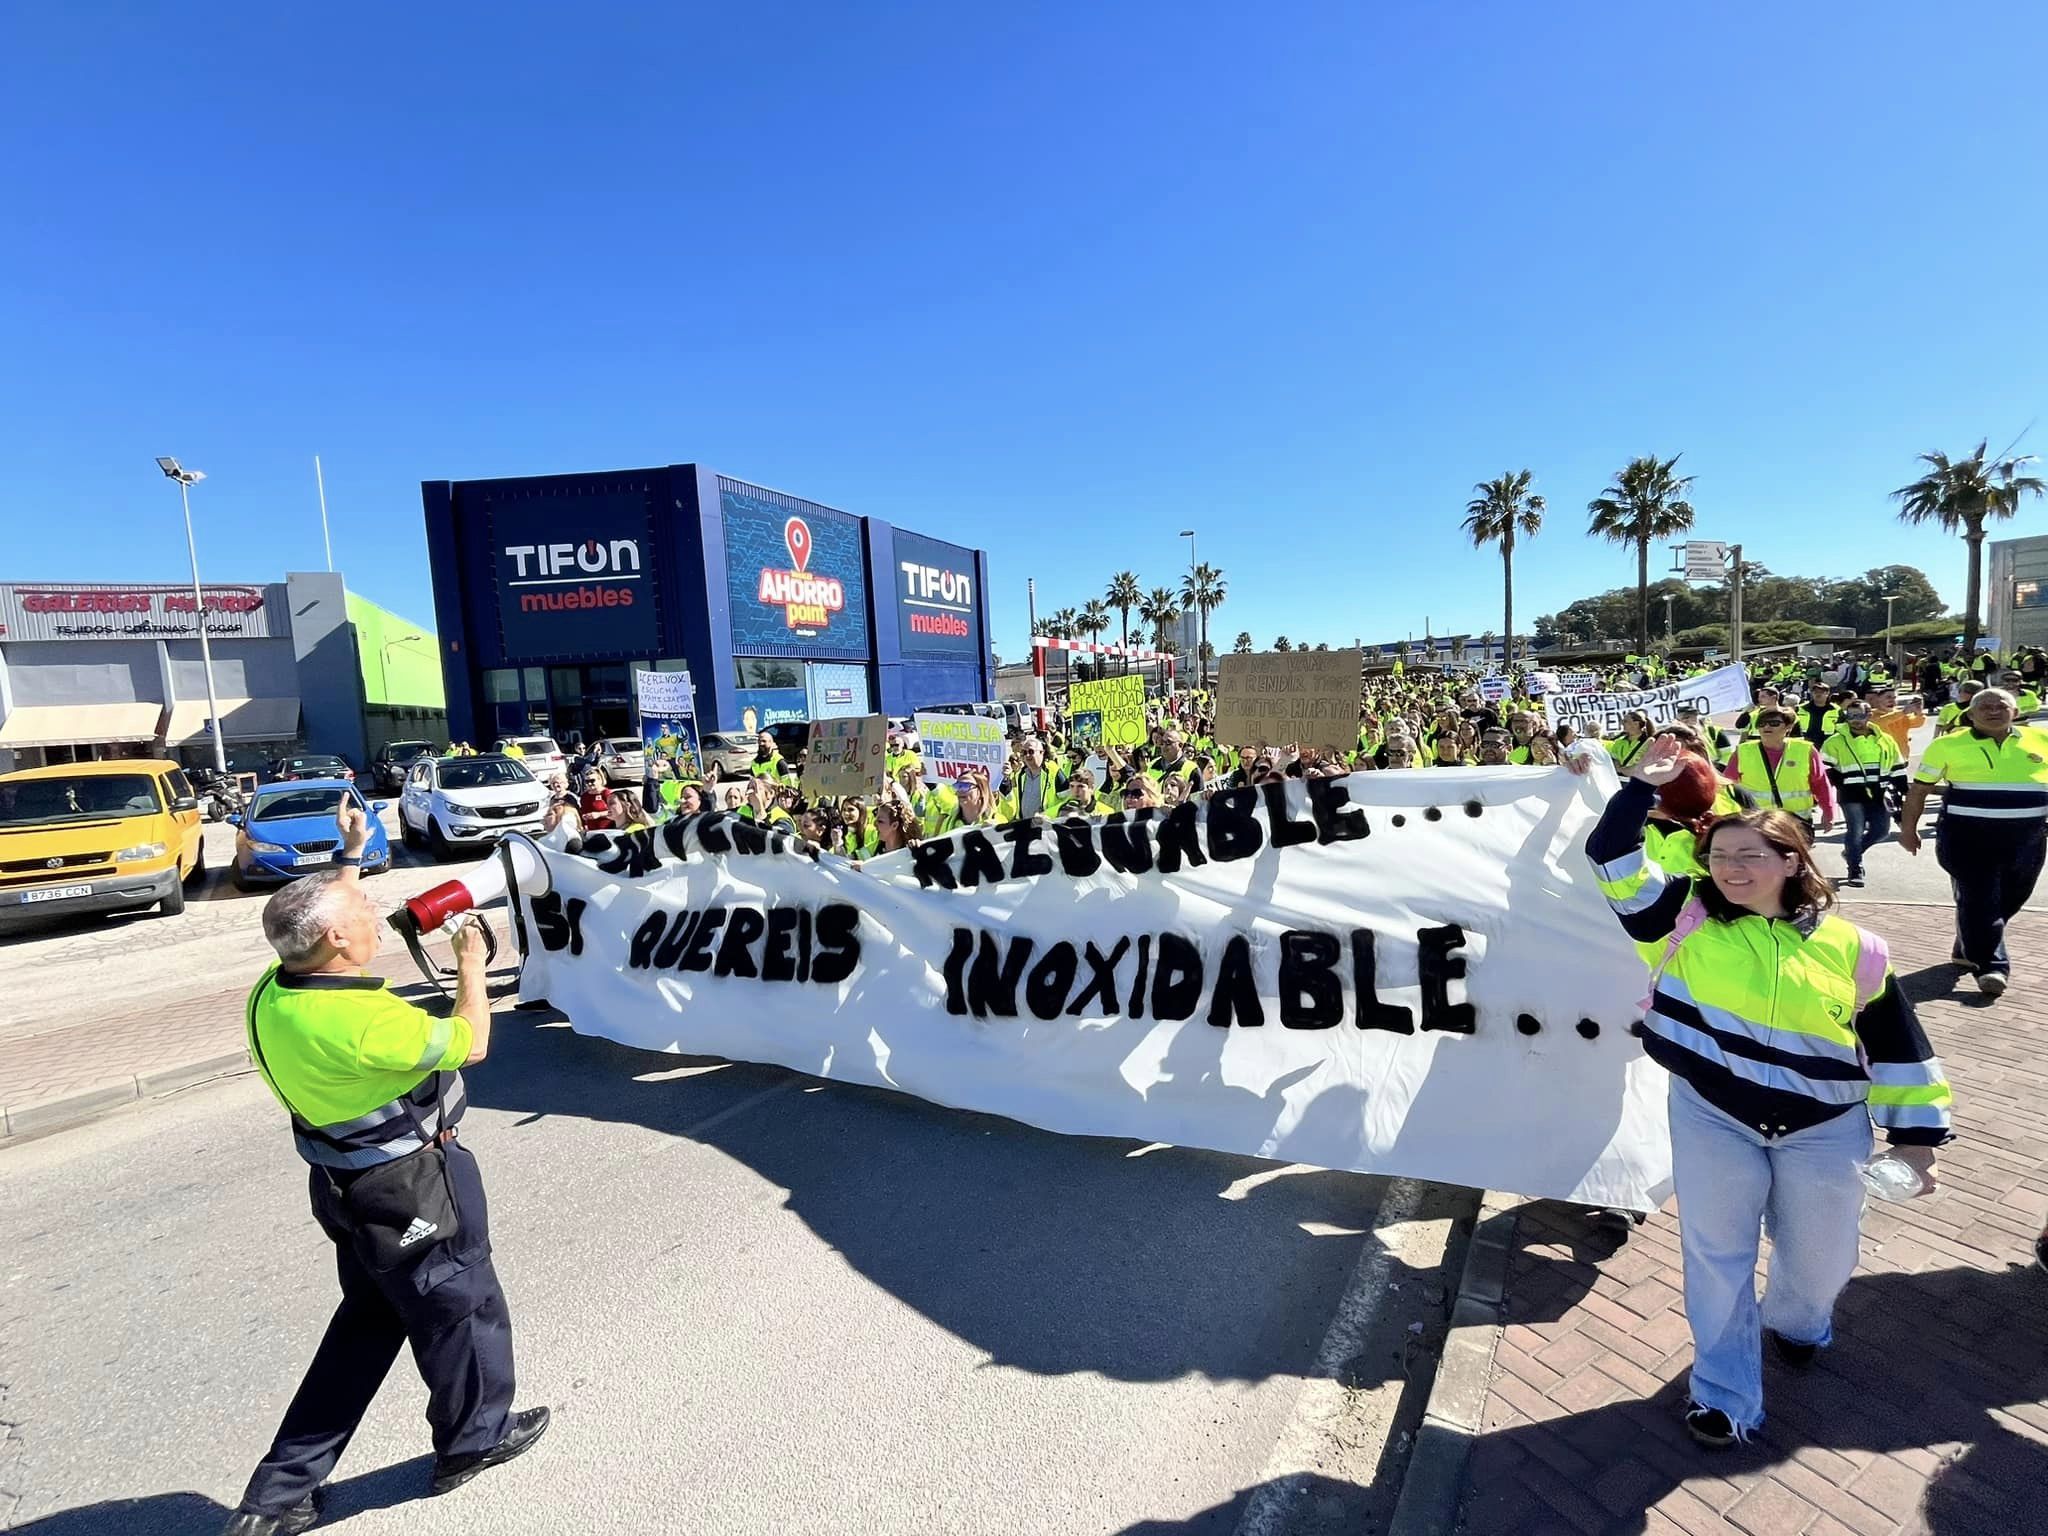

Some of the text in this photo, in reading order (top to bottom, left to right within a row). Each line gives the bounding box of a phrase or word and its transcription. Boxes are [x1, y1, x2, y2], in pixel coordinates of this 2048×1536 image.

[520, 585, 633, 612] muebles
[761, 571, 841, 608] AHORRO
[789, 603, 828, 626] point
[911, 613, 968, 637] muebles
[1245, 674, 1305, 692] RENDIR
[1290, 698, 1355, 719] HASTA
[1552, 685, 1681, 715] QUEREMOS UN
[1102, 707, 1144, 722] HORARIA
[921, 720, 1001, 743] FAMILIA
[1104, 720, 1140, 745] NO
[1276, 720, 1314, 744] FIN
[31, 889, 62, 901] 8736
[530, 890, 587, 956] SI
[629, 903, 860, 984] QUEREIS
[943, 923, 1476, 1036] INOXIDABLE
[400, 1223, 438, 1247] adidas
